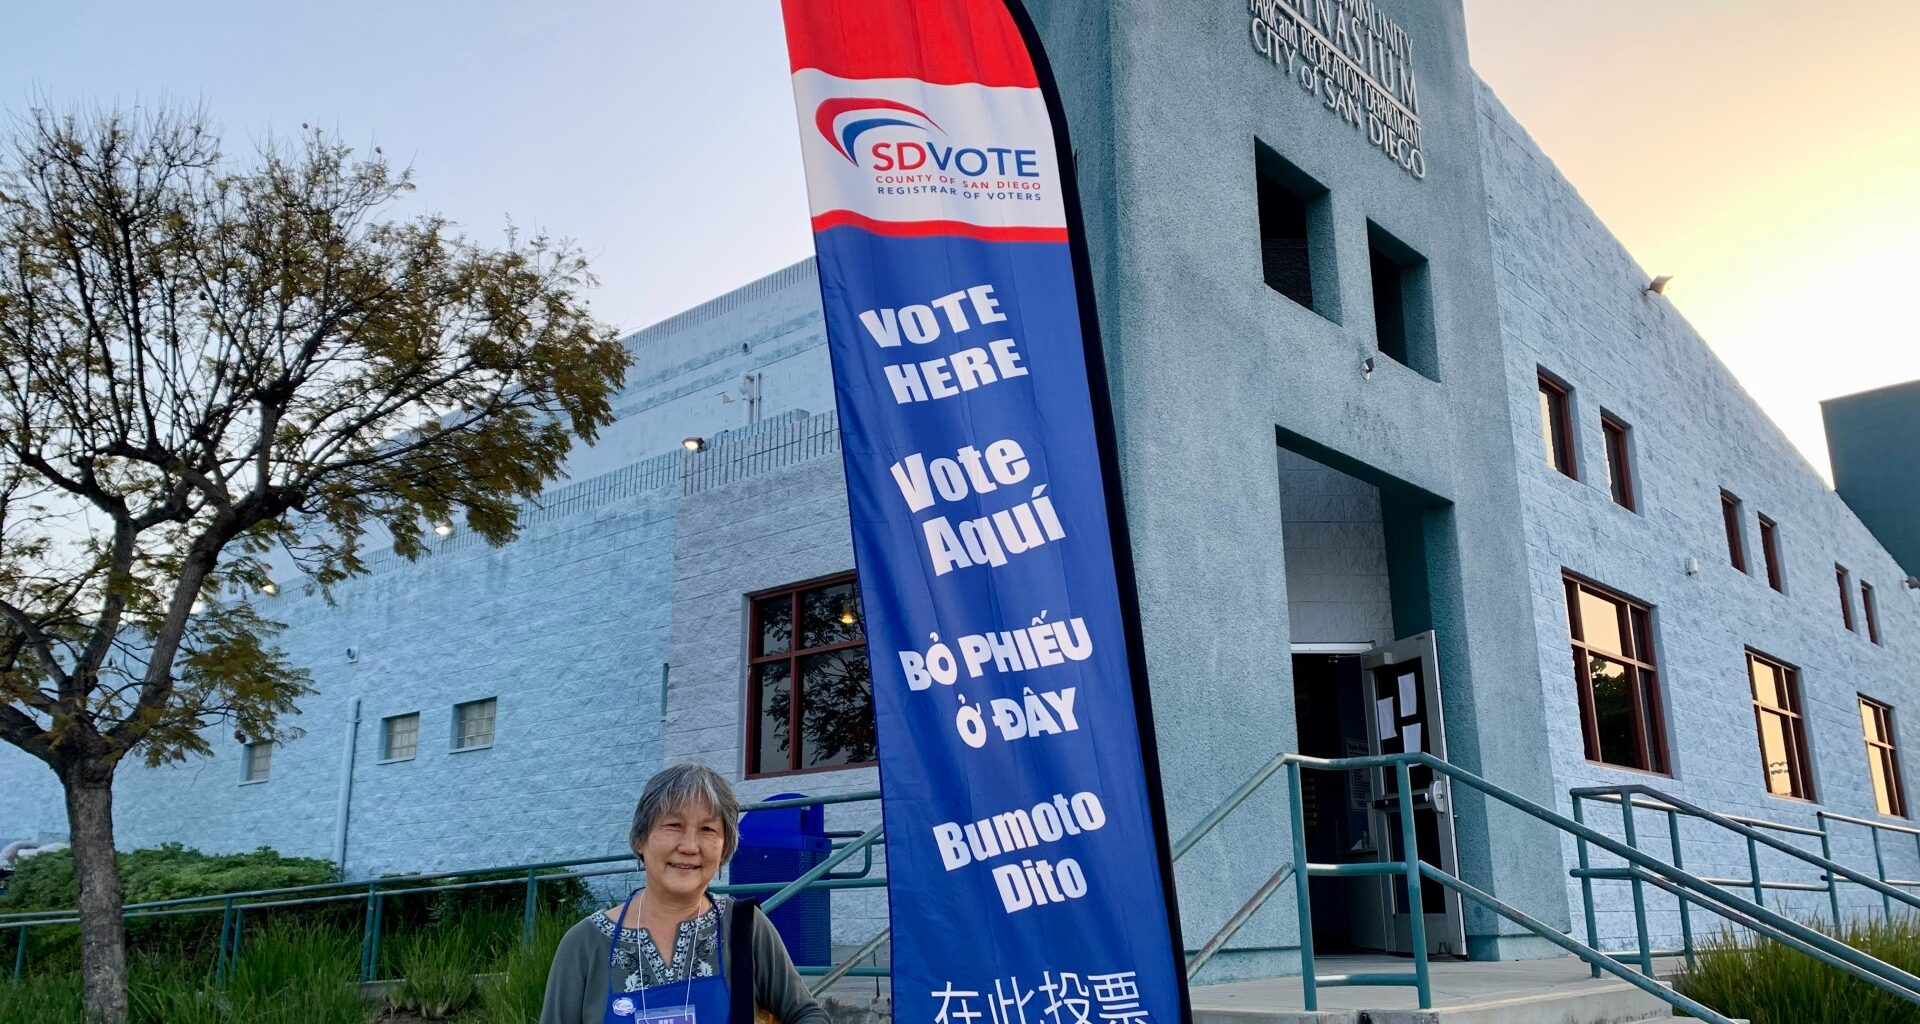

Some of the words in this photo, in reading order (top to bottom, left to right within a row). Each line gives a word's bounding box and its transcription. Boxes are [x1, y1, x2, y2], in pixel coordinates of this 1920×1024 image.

[1279, 15, 1299, 50] and
[1301, 26, 1363, 102] RECREATION
[1364, 80, 1422, 151] DEPARTMENT
[1287, 0, 1419, 115] NASIUM
[1252, 17, 1296, 75] CITY
[1301, 65, 1319, 95] of
[1324, 78, 1363, 130] SAN
[1368, 112, 1426, 179] DIEGO
[871, 141, 1040, 178] SDVOTE
[876, 174, 932, 184] COUNTY
[939, 175, 955, 184] OF
[963, 180, 989, 190] SAN
[997, 180, 1041, 190] DIEGO
[877, 185, 957, 196] REGISTRAR
[963, 191, 980, 200] OF
[988, 191, 1041, 201] VOTERS
[858, 284, 1007, 348] VOTE
[883, 338, 1029, 405] HERE
[890, 438, 1031, 514] Vote
[922, 483, 1067, 577] Aquí
[898, 631, 958, 692] BỎ
[957, 609, 1093, 678] PHIẾU
[956, 693, 987, 749] Ở
[990, 686, 1079, 742] ĐÂY
[932, 791, 1107, 872] Bumoto
[991, 857, 1088, 914] Dito
[931, 970, 1149, 1024] 在此投票
